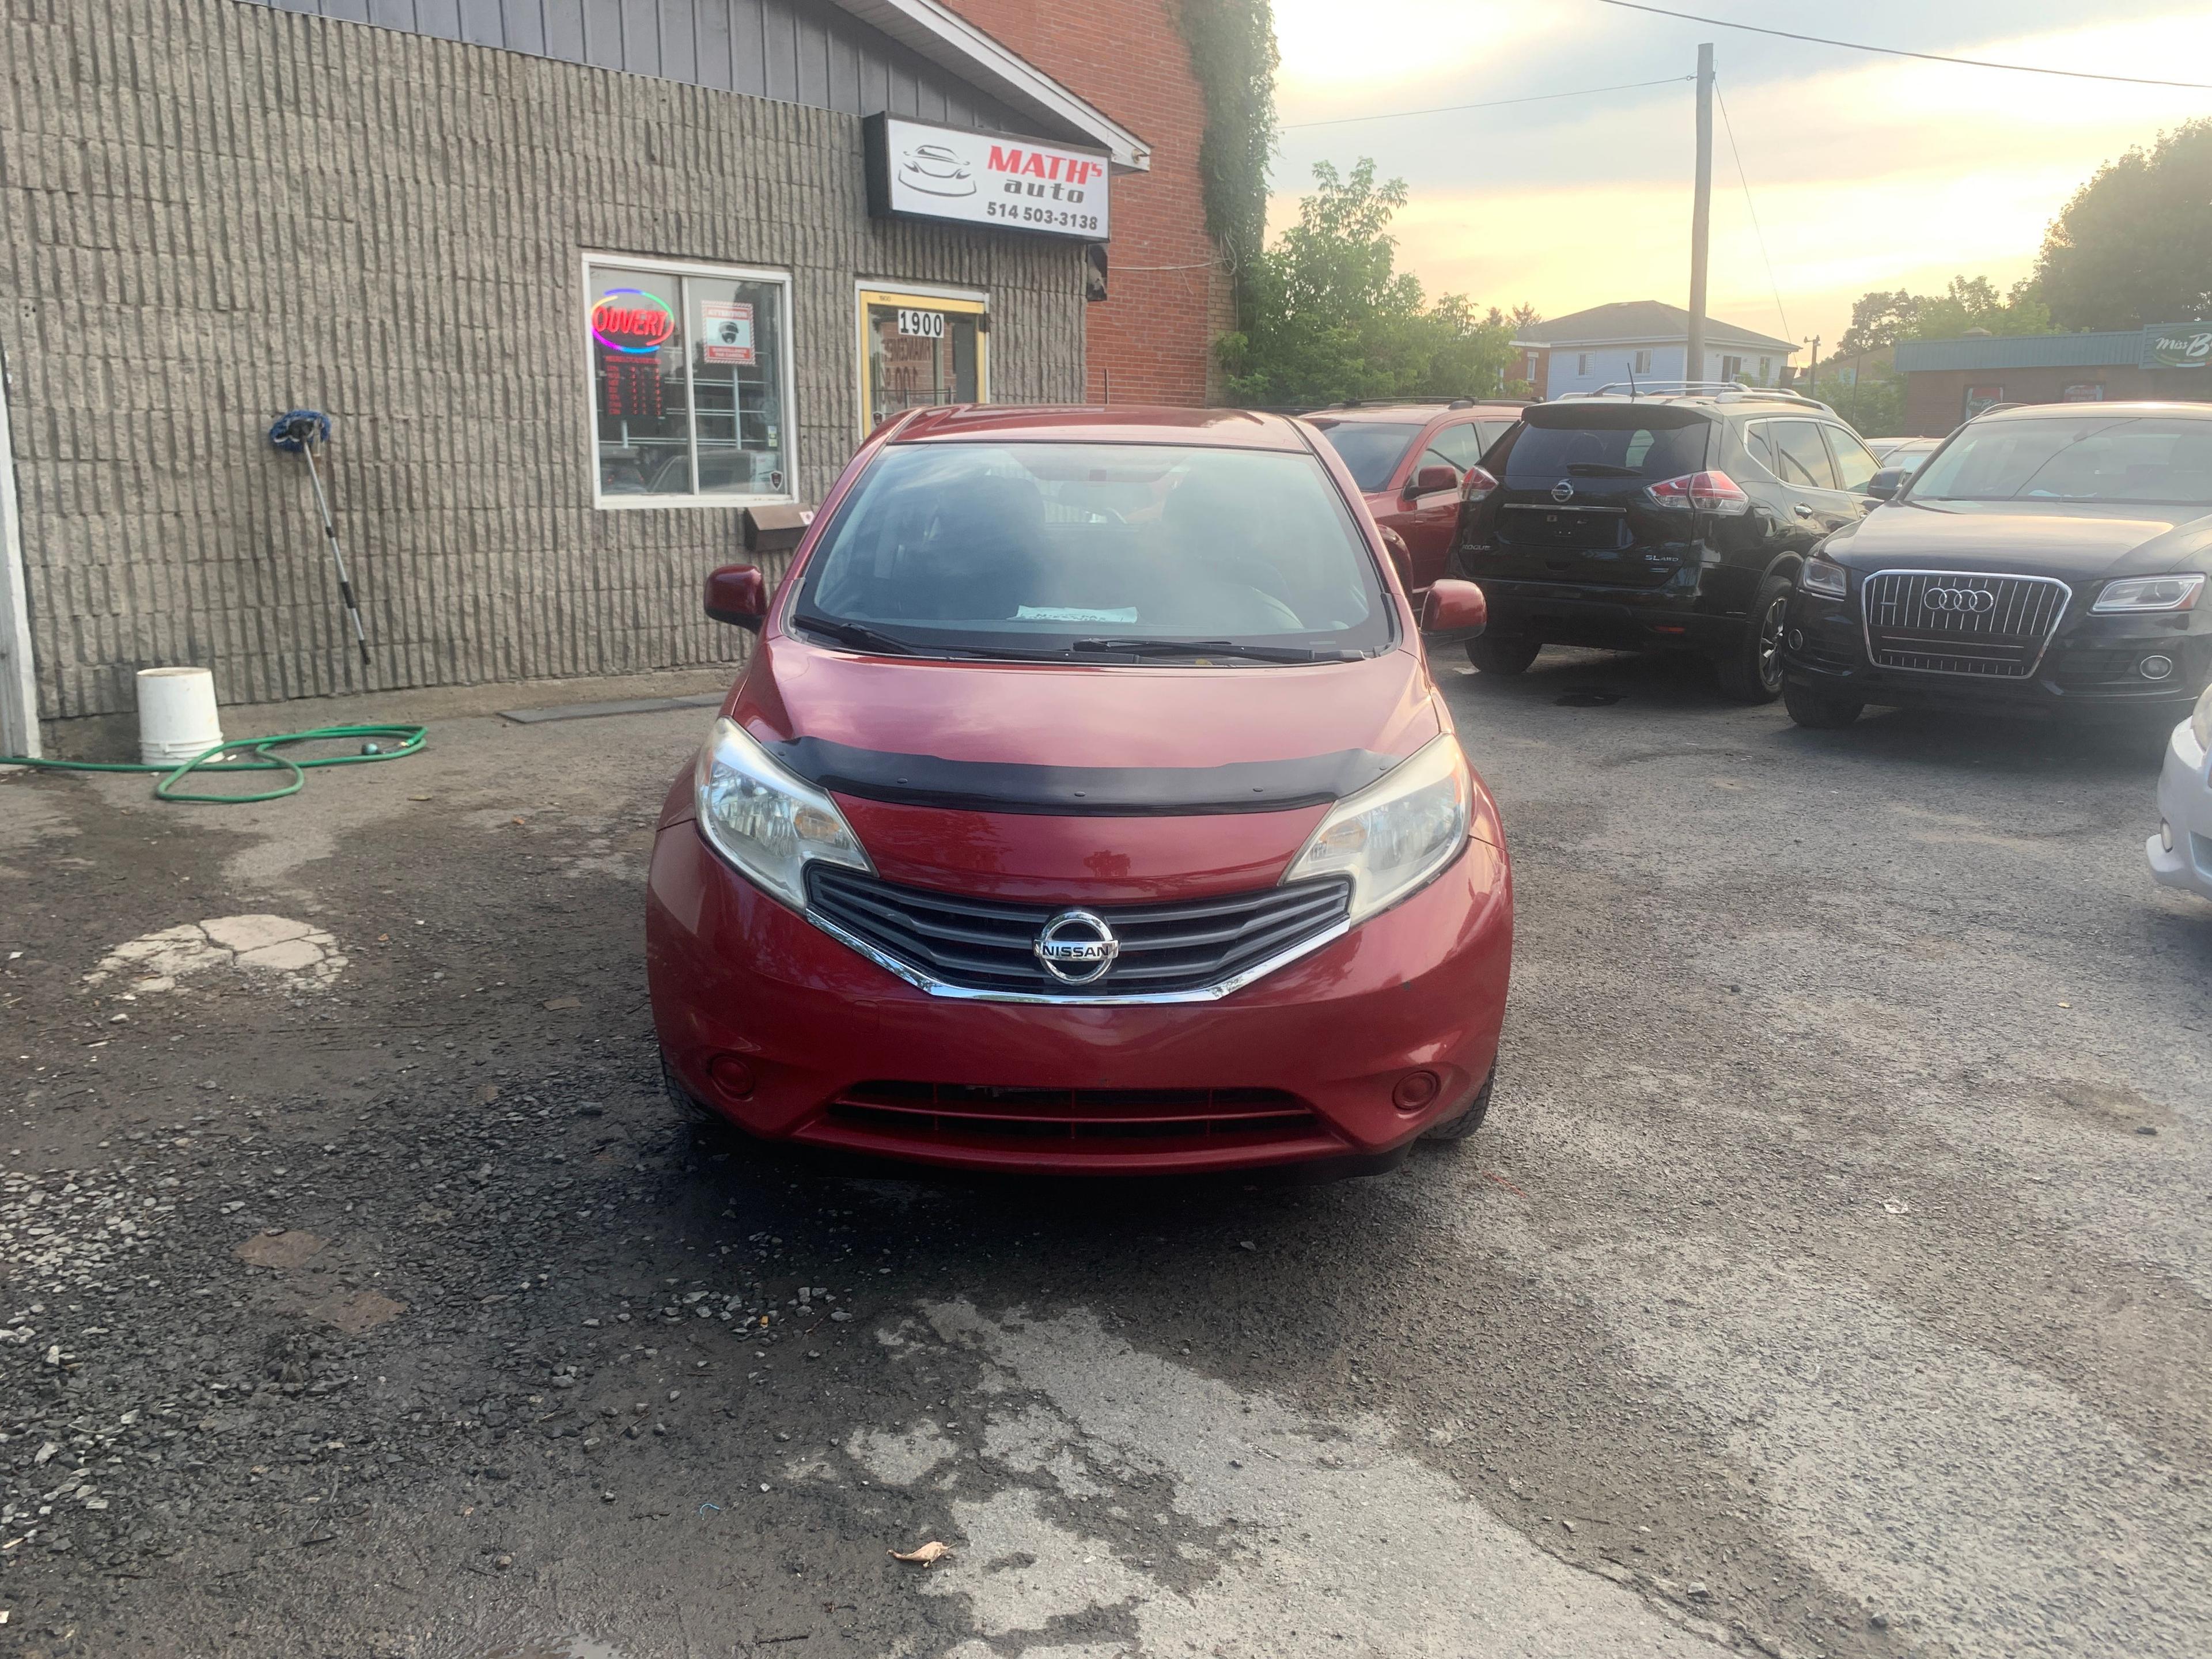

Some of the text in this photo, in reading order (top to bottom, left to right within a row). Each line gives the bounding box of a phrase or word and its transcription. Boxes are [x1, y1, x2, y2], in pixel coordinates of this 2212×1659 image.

[1003, 179, 1085, 204] auto
[987, 201, 1098, 230] 514 503-3138
[592, 305, 668, 336] OUVERT
[900, 310, 942, 336] 1900
[2186, 332, 2212, 357] B
[1043, 945, 1109, 958] NISSAN
